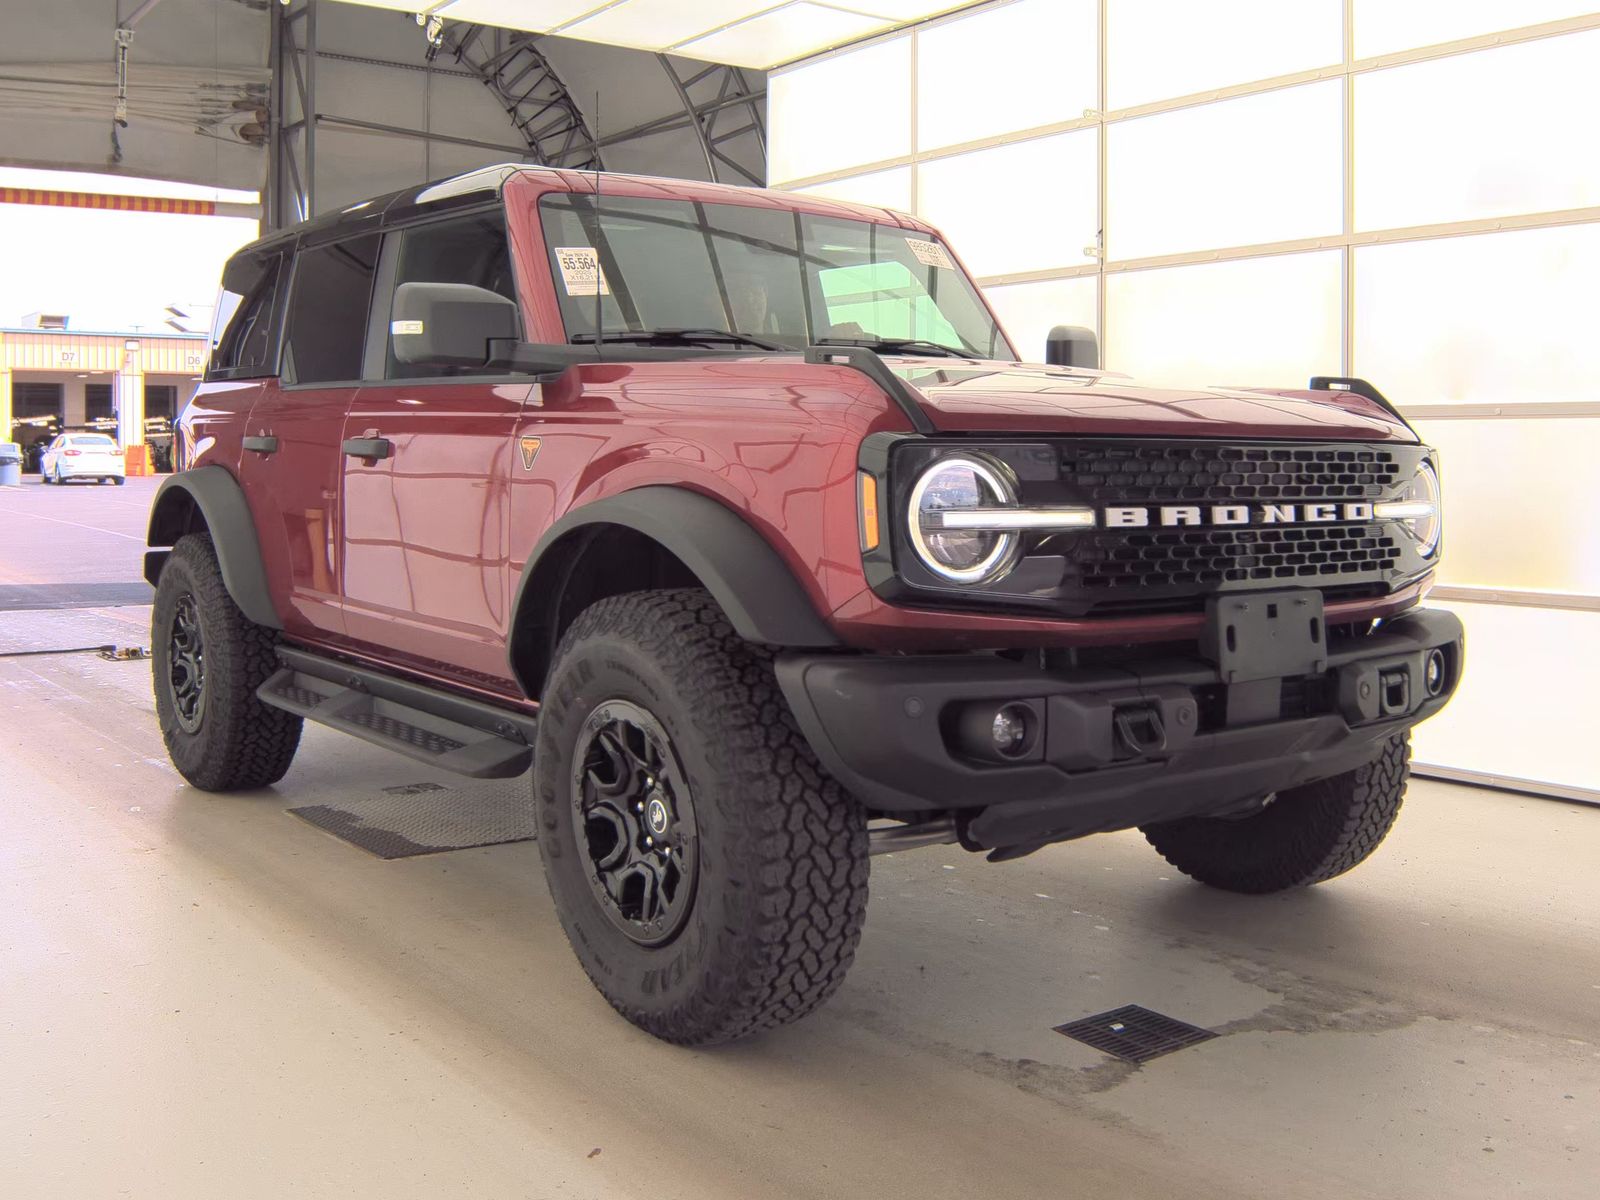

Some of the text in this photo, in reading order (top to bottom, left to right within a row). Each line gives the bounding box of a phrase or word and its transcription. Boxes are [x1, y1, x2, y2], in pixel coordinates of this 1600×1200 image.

[62, 352, 75, 361] D7
[187, 356, 201, 365] D6
[1105, 503, 1373, 527] BRONCO
